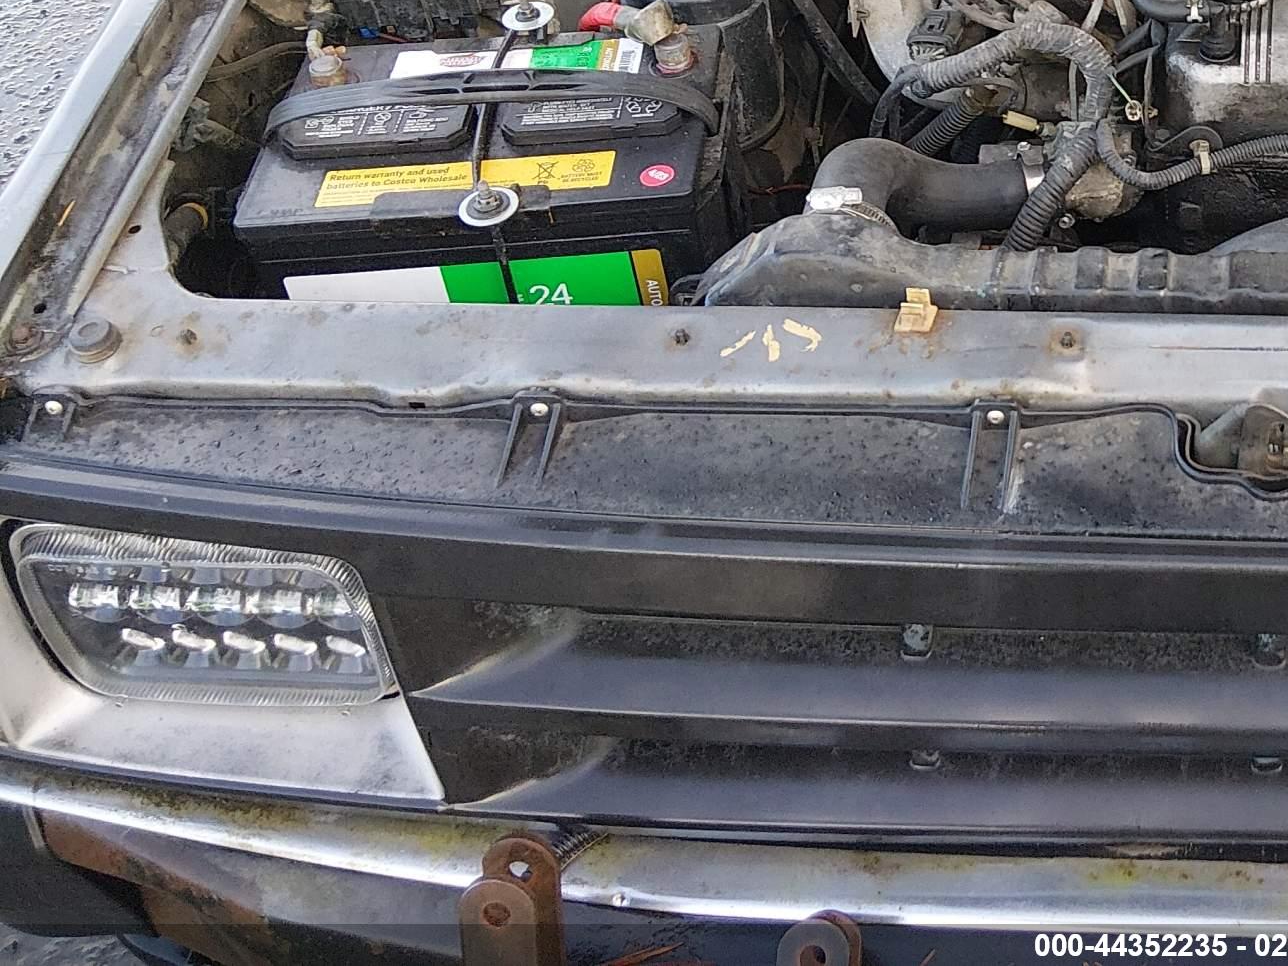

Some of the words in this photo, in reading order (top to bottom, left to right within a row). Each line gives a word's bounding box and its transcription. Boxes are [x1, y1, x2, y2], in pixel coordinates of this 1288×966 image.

[364, 170, 405, 178] warranty
[407, 168, 425, 176] and
[427, 166, 450, 175] used
[326, 181, 369, 190] batteries
[384, 178, 416, 186] Costco
[419, 174, 467, 184] Wholesale
[529, 283, 573, 306] 24
